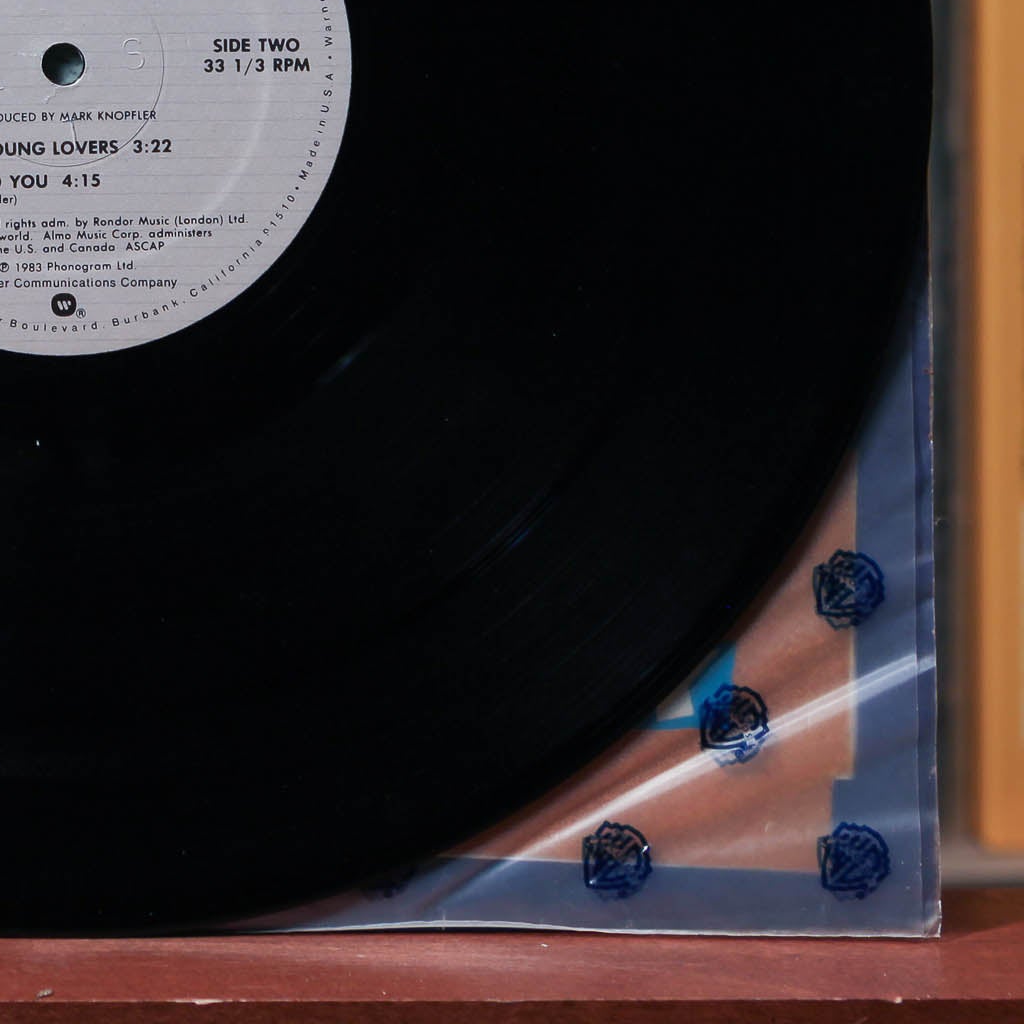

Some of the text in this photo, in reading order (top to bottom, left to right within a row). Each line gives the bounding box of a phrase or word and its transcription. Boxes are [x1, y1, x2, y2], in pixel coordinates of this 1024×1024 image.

[212, 37, 301, 54] SIDE TWO
[203, 58, 225, 74] 33
[272, 57, 311, 73] RPM
[41, 111, 56, 122] BY
[59, 110, 94, 123] MARK
[96, 109, 158, 122] KNOPFLER
[52, 139, 120, 157] LOVERS
[132, 138, 173, 155] 3:22
[9, 173, 48, 189] YOU
[61, 173, 101, 188] 4:15
[189, 239, 263, 298] California
[298, 140, 321, 181] Made
[316, 119, 327, 134] in
[5, 218, 37, 231] rights
[75, 216, 89, 230] by
[93, 215, 134, 227] Rondor
[138, 215, 170, 226] Music
[174, 214, 224, 228] (London)
[228, 213, 249, 225] Ltd.
[43, 229, 72, 241] Almo
[76, 228, 108, 240] Music
[148, 227, 213, 239] administers
[14, 243, 37, 255] U.S.
[42, 242, 65, 254] and
[69, 241, 116, 254] Canada
[125, 240, 165, 252] ASCAP
[15, 262, 42, 273] 1983
[47, 261, 112, 274] Phonogram
[116, 259, 137, 271] Ltd.
[13, 277, 117, 289] Communications
[120, 276, 178, 290] Company
